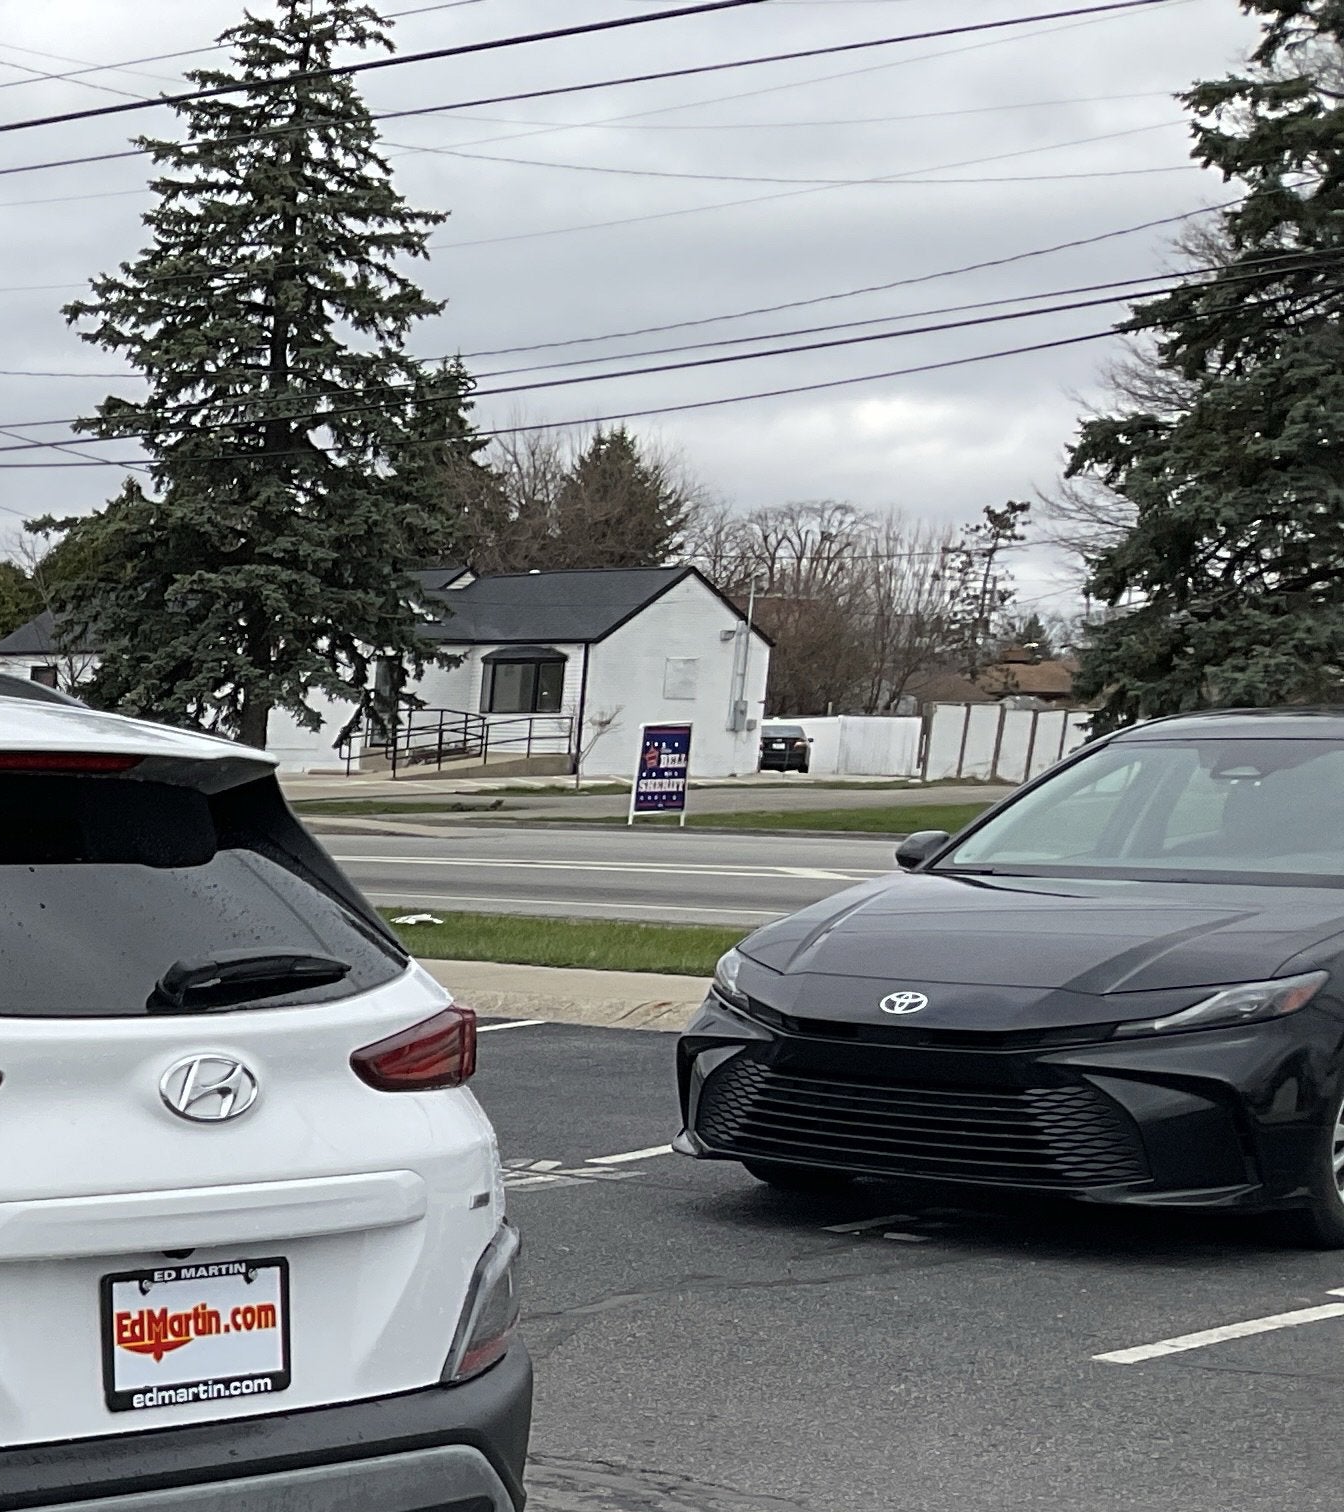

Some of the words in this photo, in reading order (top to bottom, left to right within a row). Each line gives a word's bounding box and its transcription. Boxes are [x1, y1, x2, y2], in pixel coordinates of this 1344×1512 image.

[153, 1269, 177, 1282] ED
[180, 1262, 247, 1280] MARTIN
[132, 1377, 272, 1408] edmartin.com
